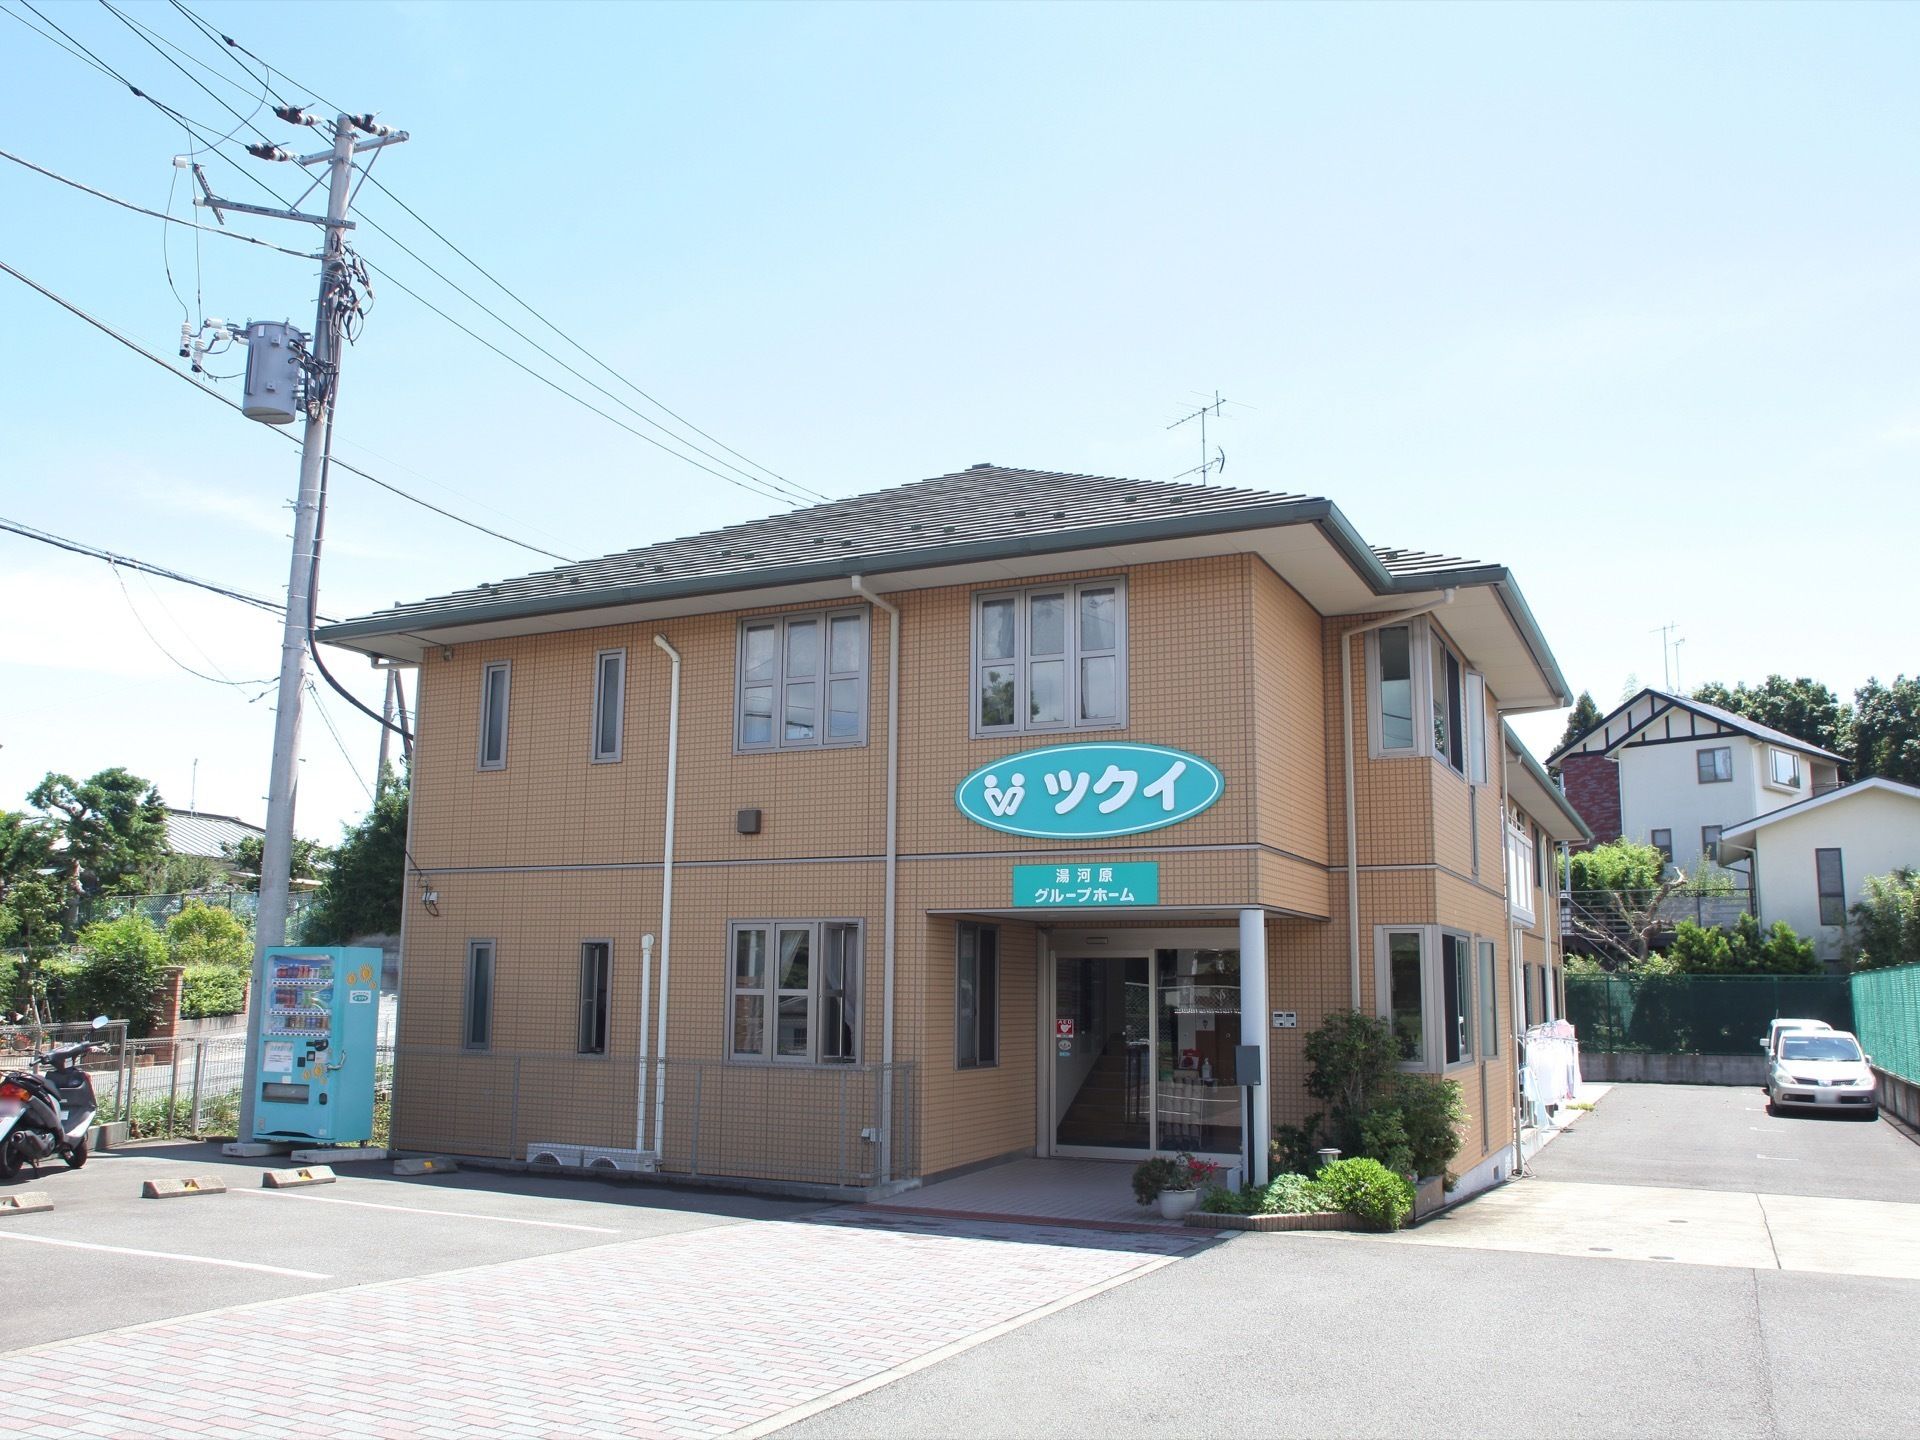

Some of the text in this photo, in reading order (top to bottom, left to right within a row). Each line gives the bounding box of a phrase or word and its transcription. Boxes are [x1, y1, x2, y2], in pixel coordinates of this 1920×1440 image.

[1044, 761, 1187, 815] ツクイ
[1056, 868, 1113, 883] 湯河原
[1034, 887, 1135, 904] グループホーム
